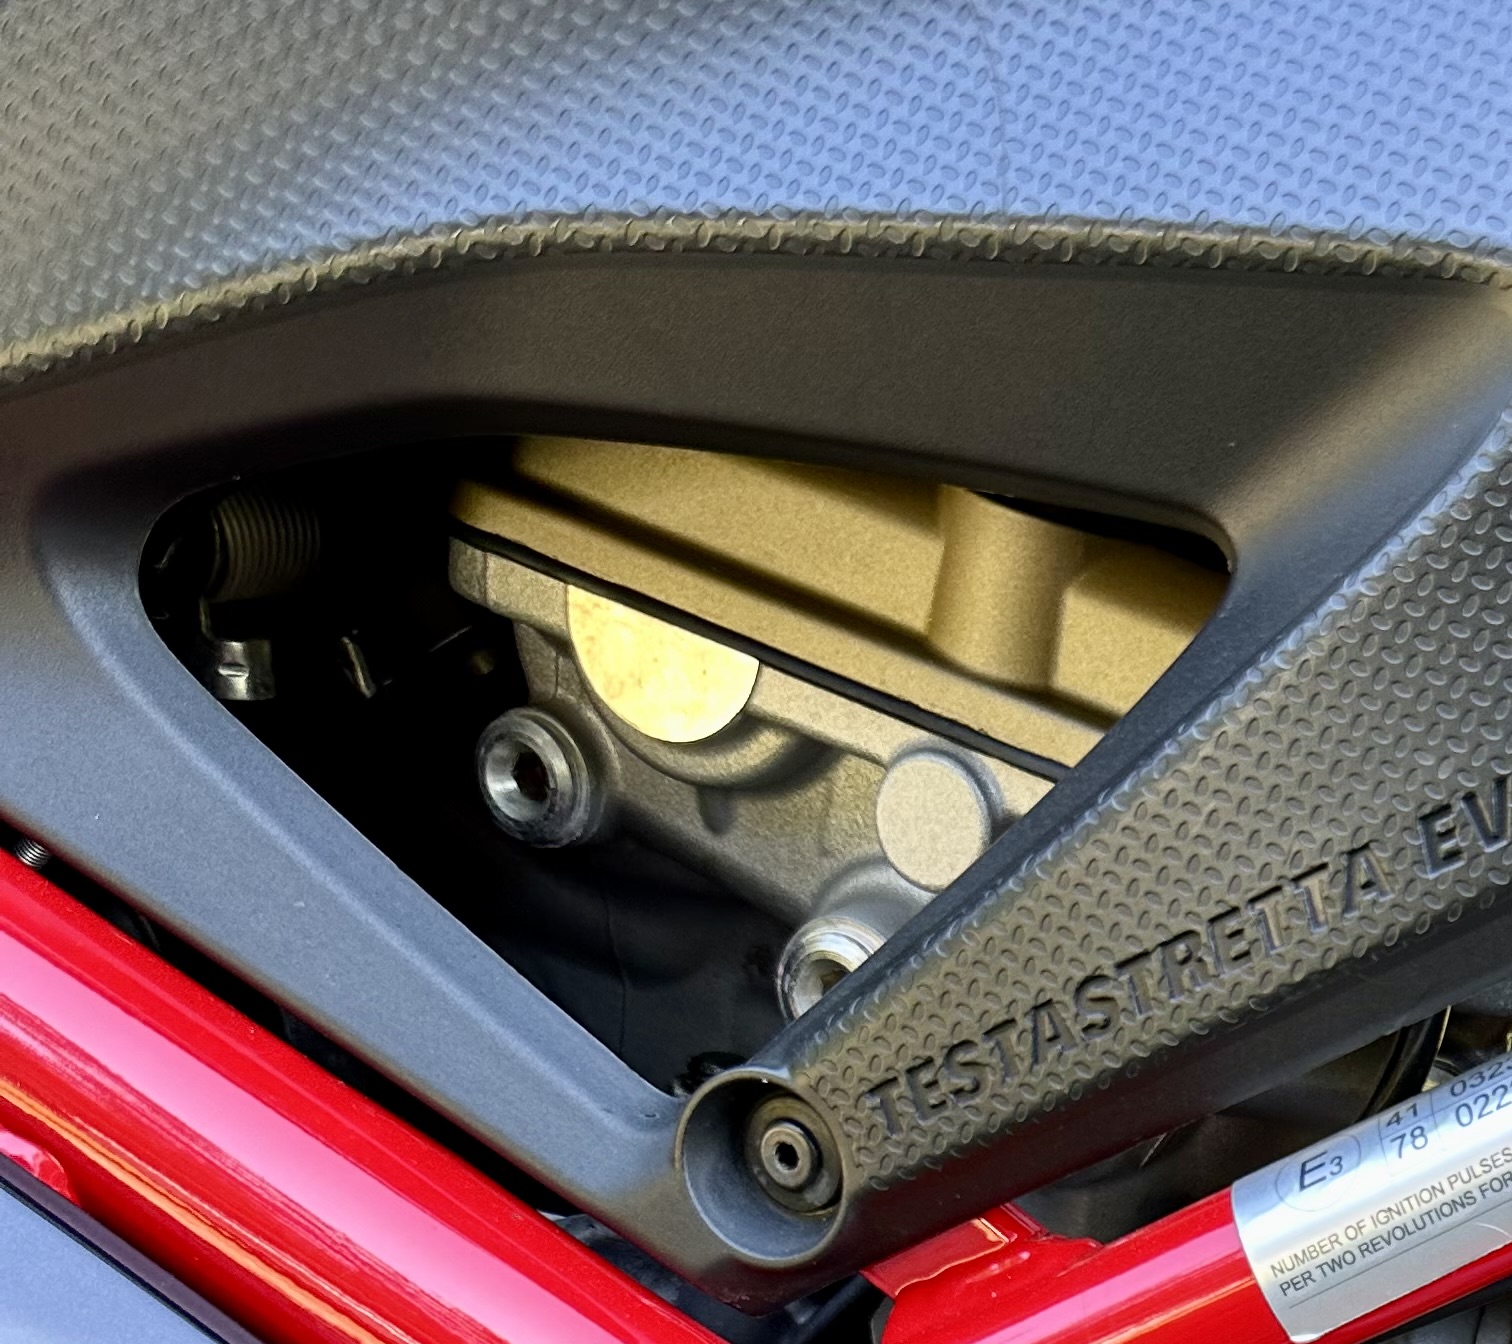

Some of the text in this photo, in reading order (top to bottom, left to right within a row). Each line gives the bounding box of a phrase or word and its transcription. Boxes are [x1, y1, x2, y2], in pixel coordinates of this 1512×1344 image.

[867, 842, 1392, 1140] TESTASTRETTA
[1387, 1103, 1418, 1128] 41
[1390, 1126, 1428, 1159] 78
[1299, 1150, 1343, 1192] E3
[1270, 1233, 1343, 1278] NUMBER
[1344, 1219, 1367, 1241] OF
[1370, 1182, 1445, 1229] IGNITION
[1279, 1271, 1316, 1296] PER
[1315, 1250, 1356, 1280] TWO
[1358, 1190, 1477, 1259] REVOLUTIONS
